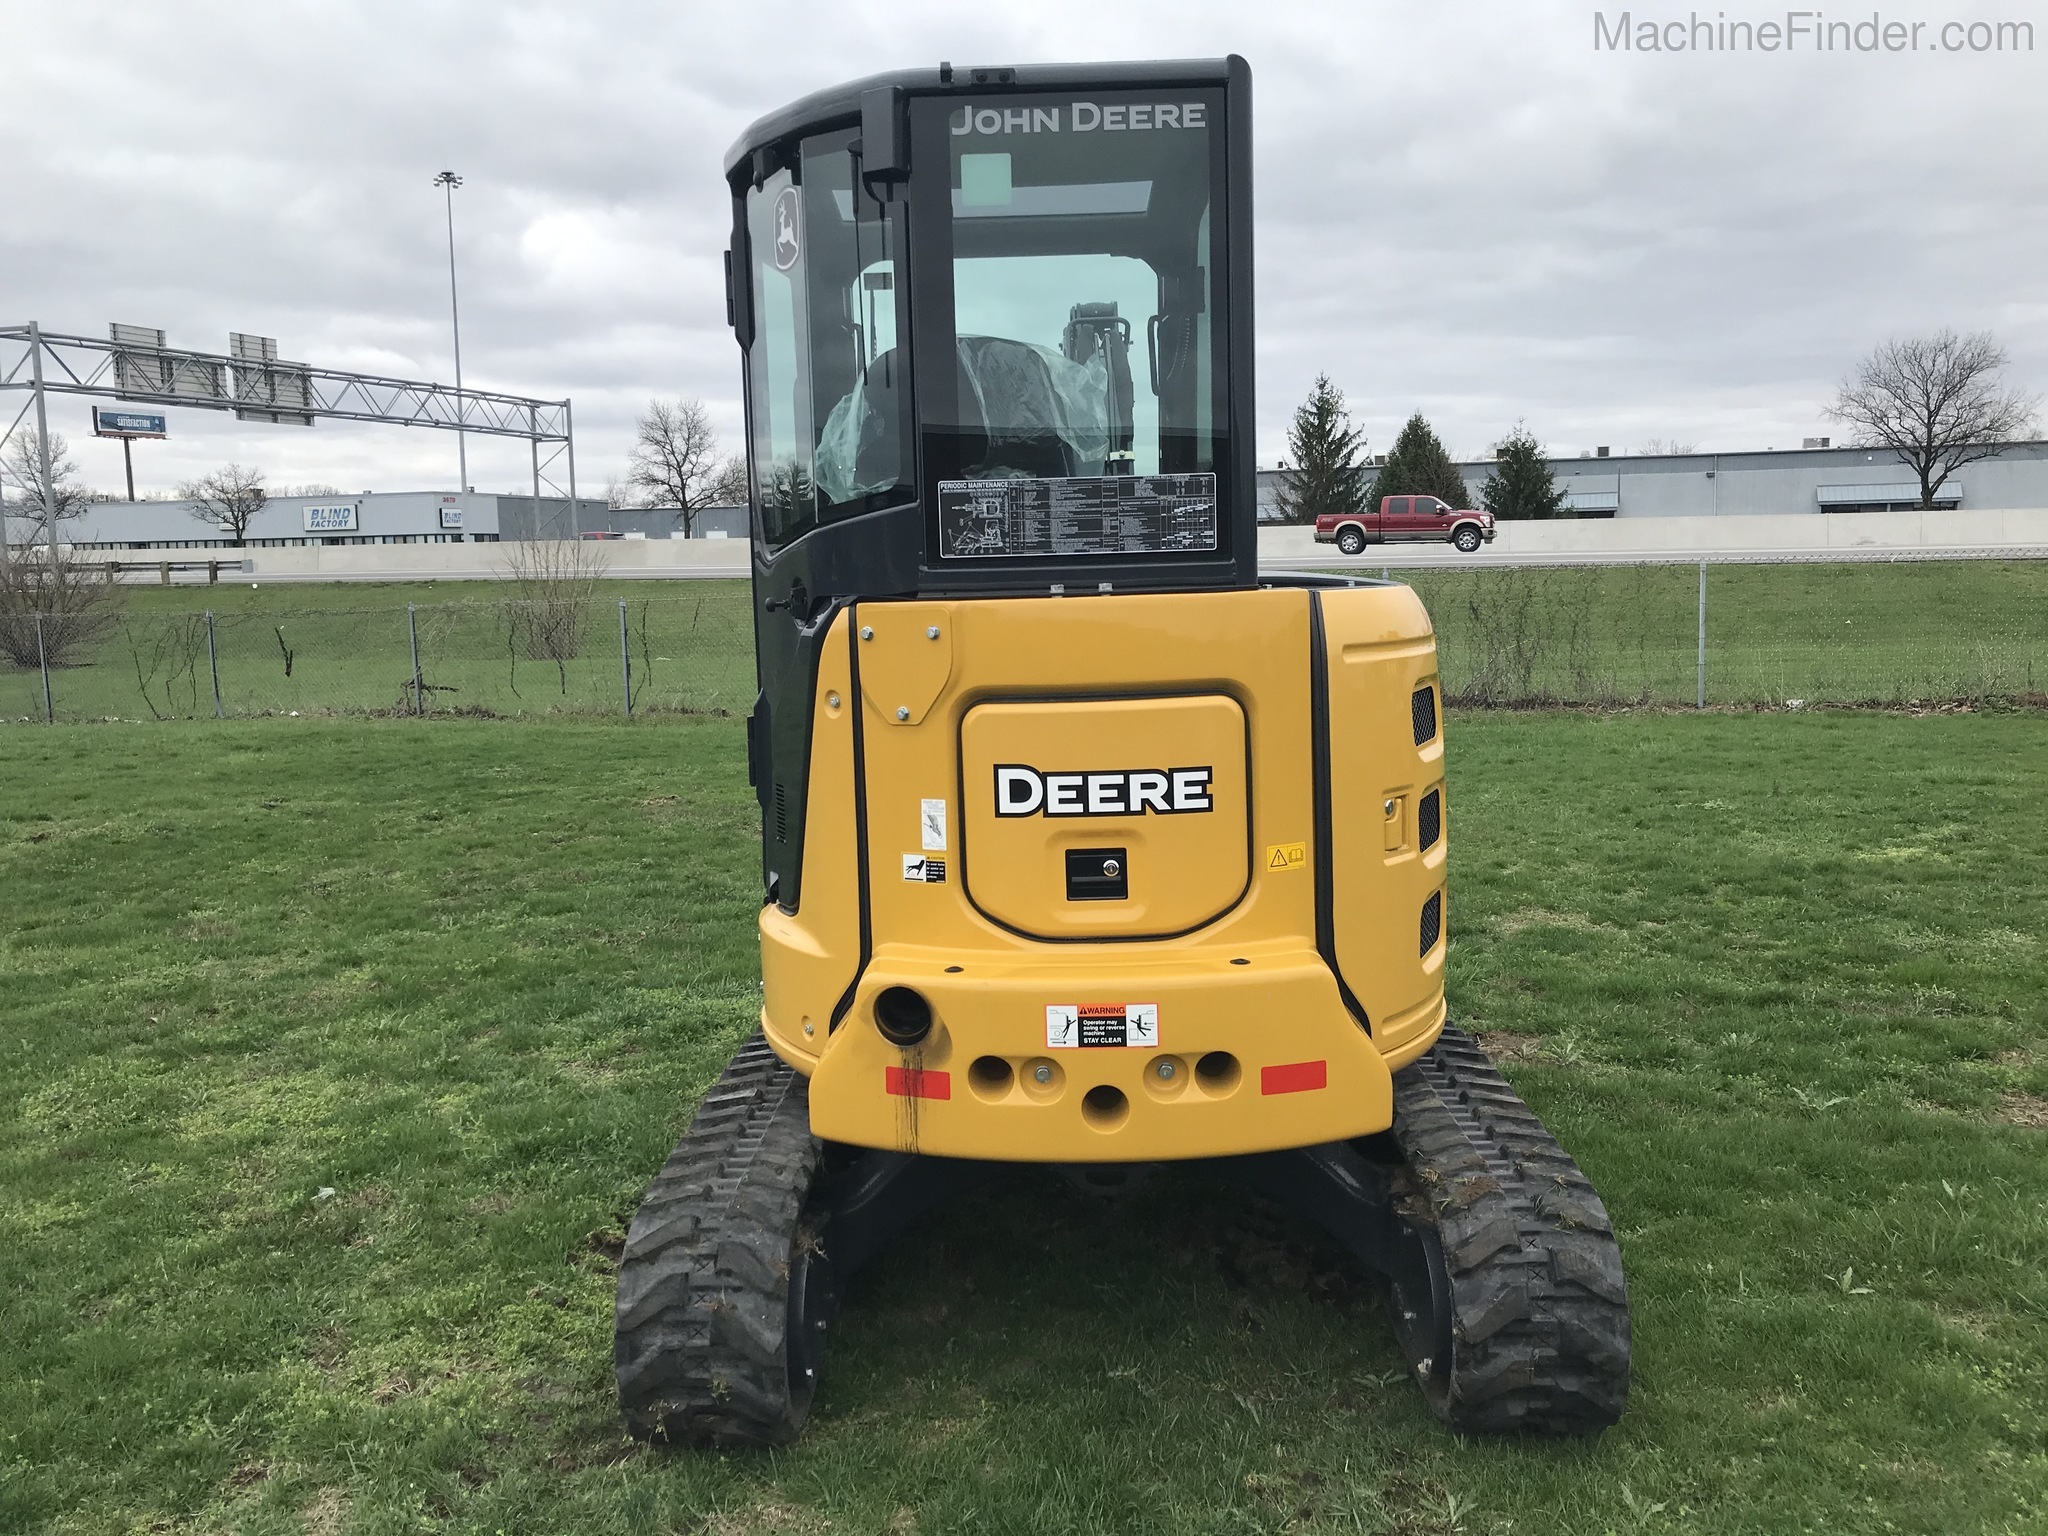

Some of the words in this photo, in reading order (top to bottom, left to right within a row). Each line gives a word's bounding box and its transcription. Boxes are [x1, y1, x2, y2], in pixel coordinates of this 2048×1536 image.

[951, 104, 1060, 136] JOHN
[1072, 101, 1206, 132] DEERE
[116, 418, 150, 428] SATISFACTION
[310, 508, 351, 520] BLIND
[994, 764, 1213, 818] DEERE
